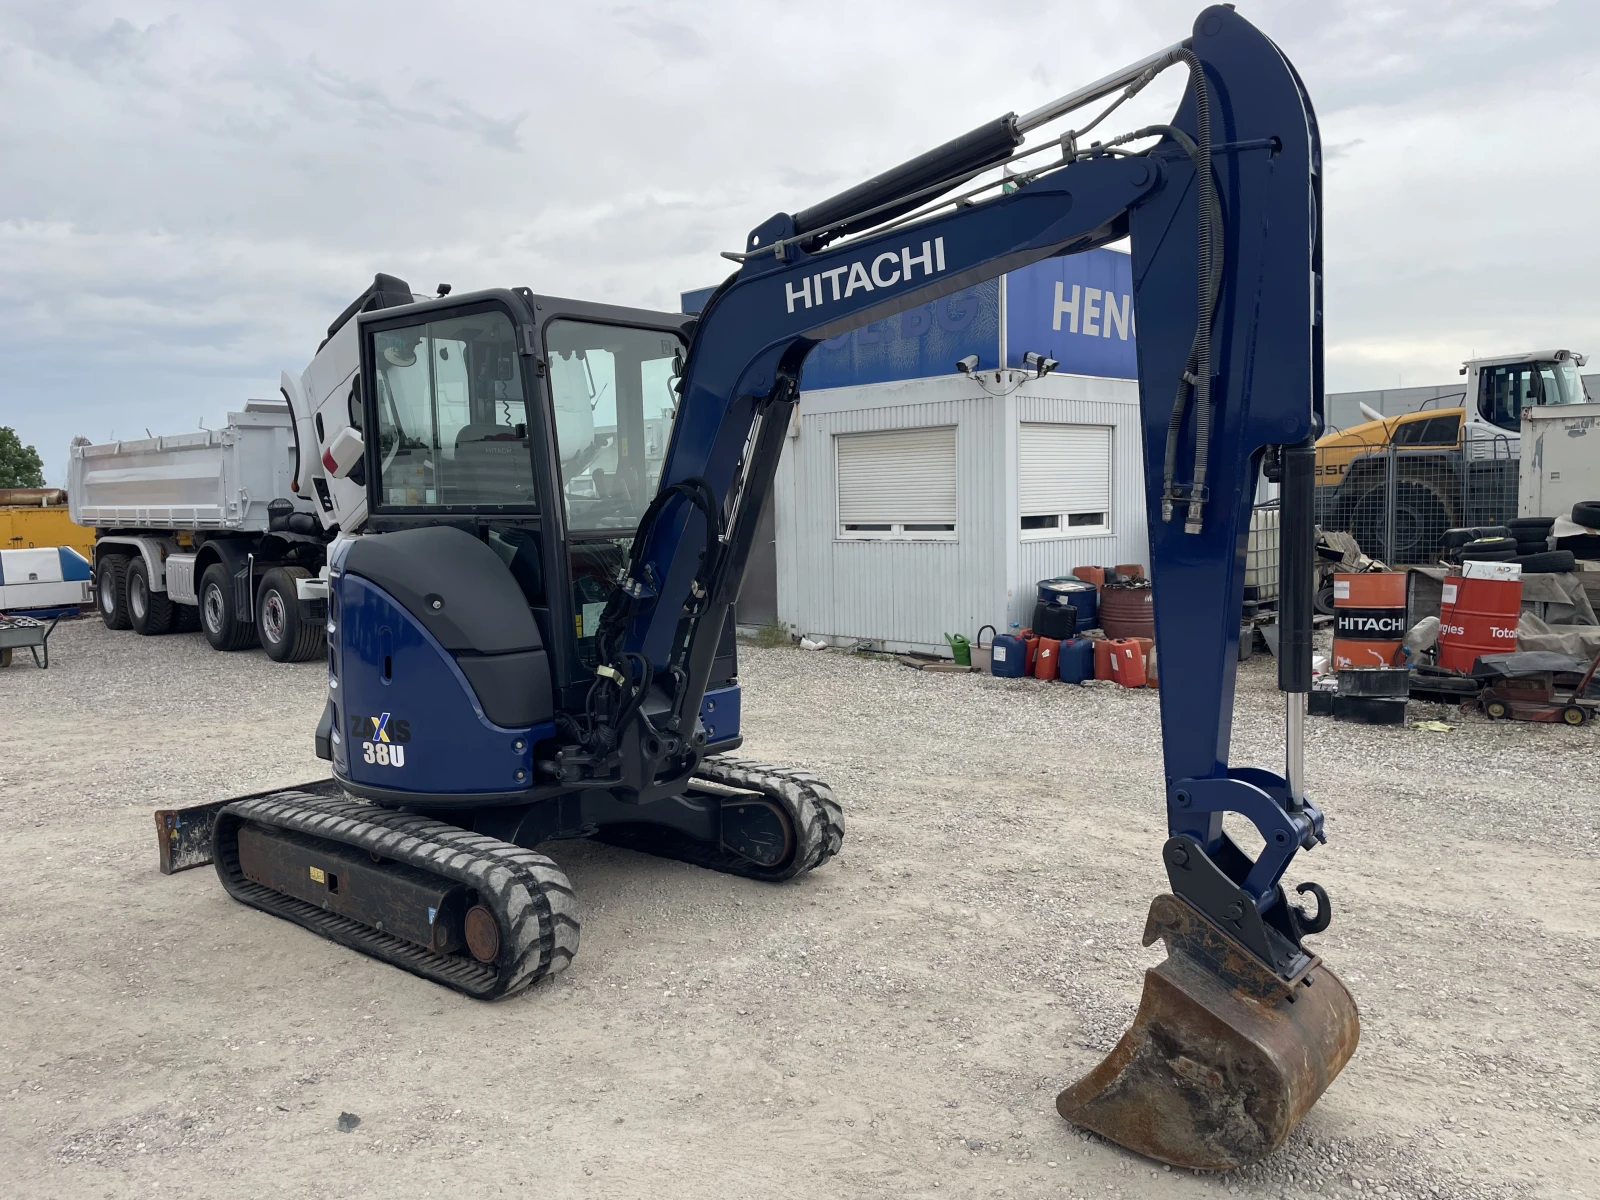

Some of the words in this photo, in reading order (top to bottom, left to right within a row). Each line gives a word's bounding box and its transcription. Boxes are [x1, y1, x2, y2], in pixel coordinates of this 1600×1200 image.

[785, 236, 946, 314] HITACHI
[1053, 281, 1136, 341] HEN
[1338, 616, 1404, 631] HITACHI
[1438, 622, 1465, 636] rgies
[350, 712, 412, 743] ZAXIS
[362, 741, 405, 768] 38U
